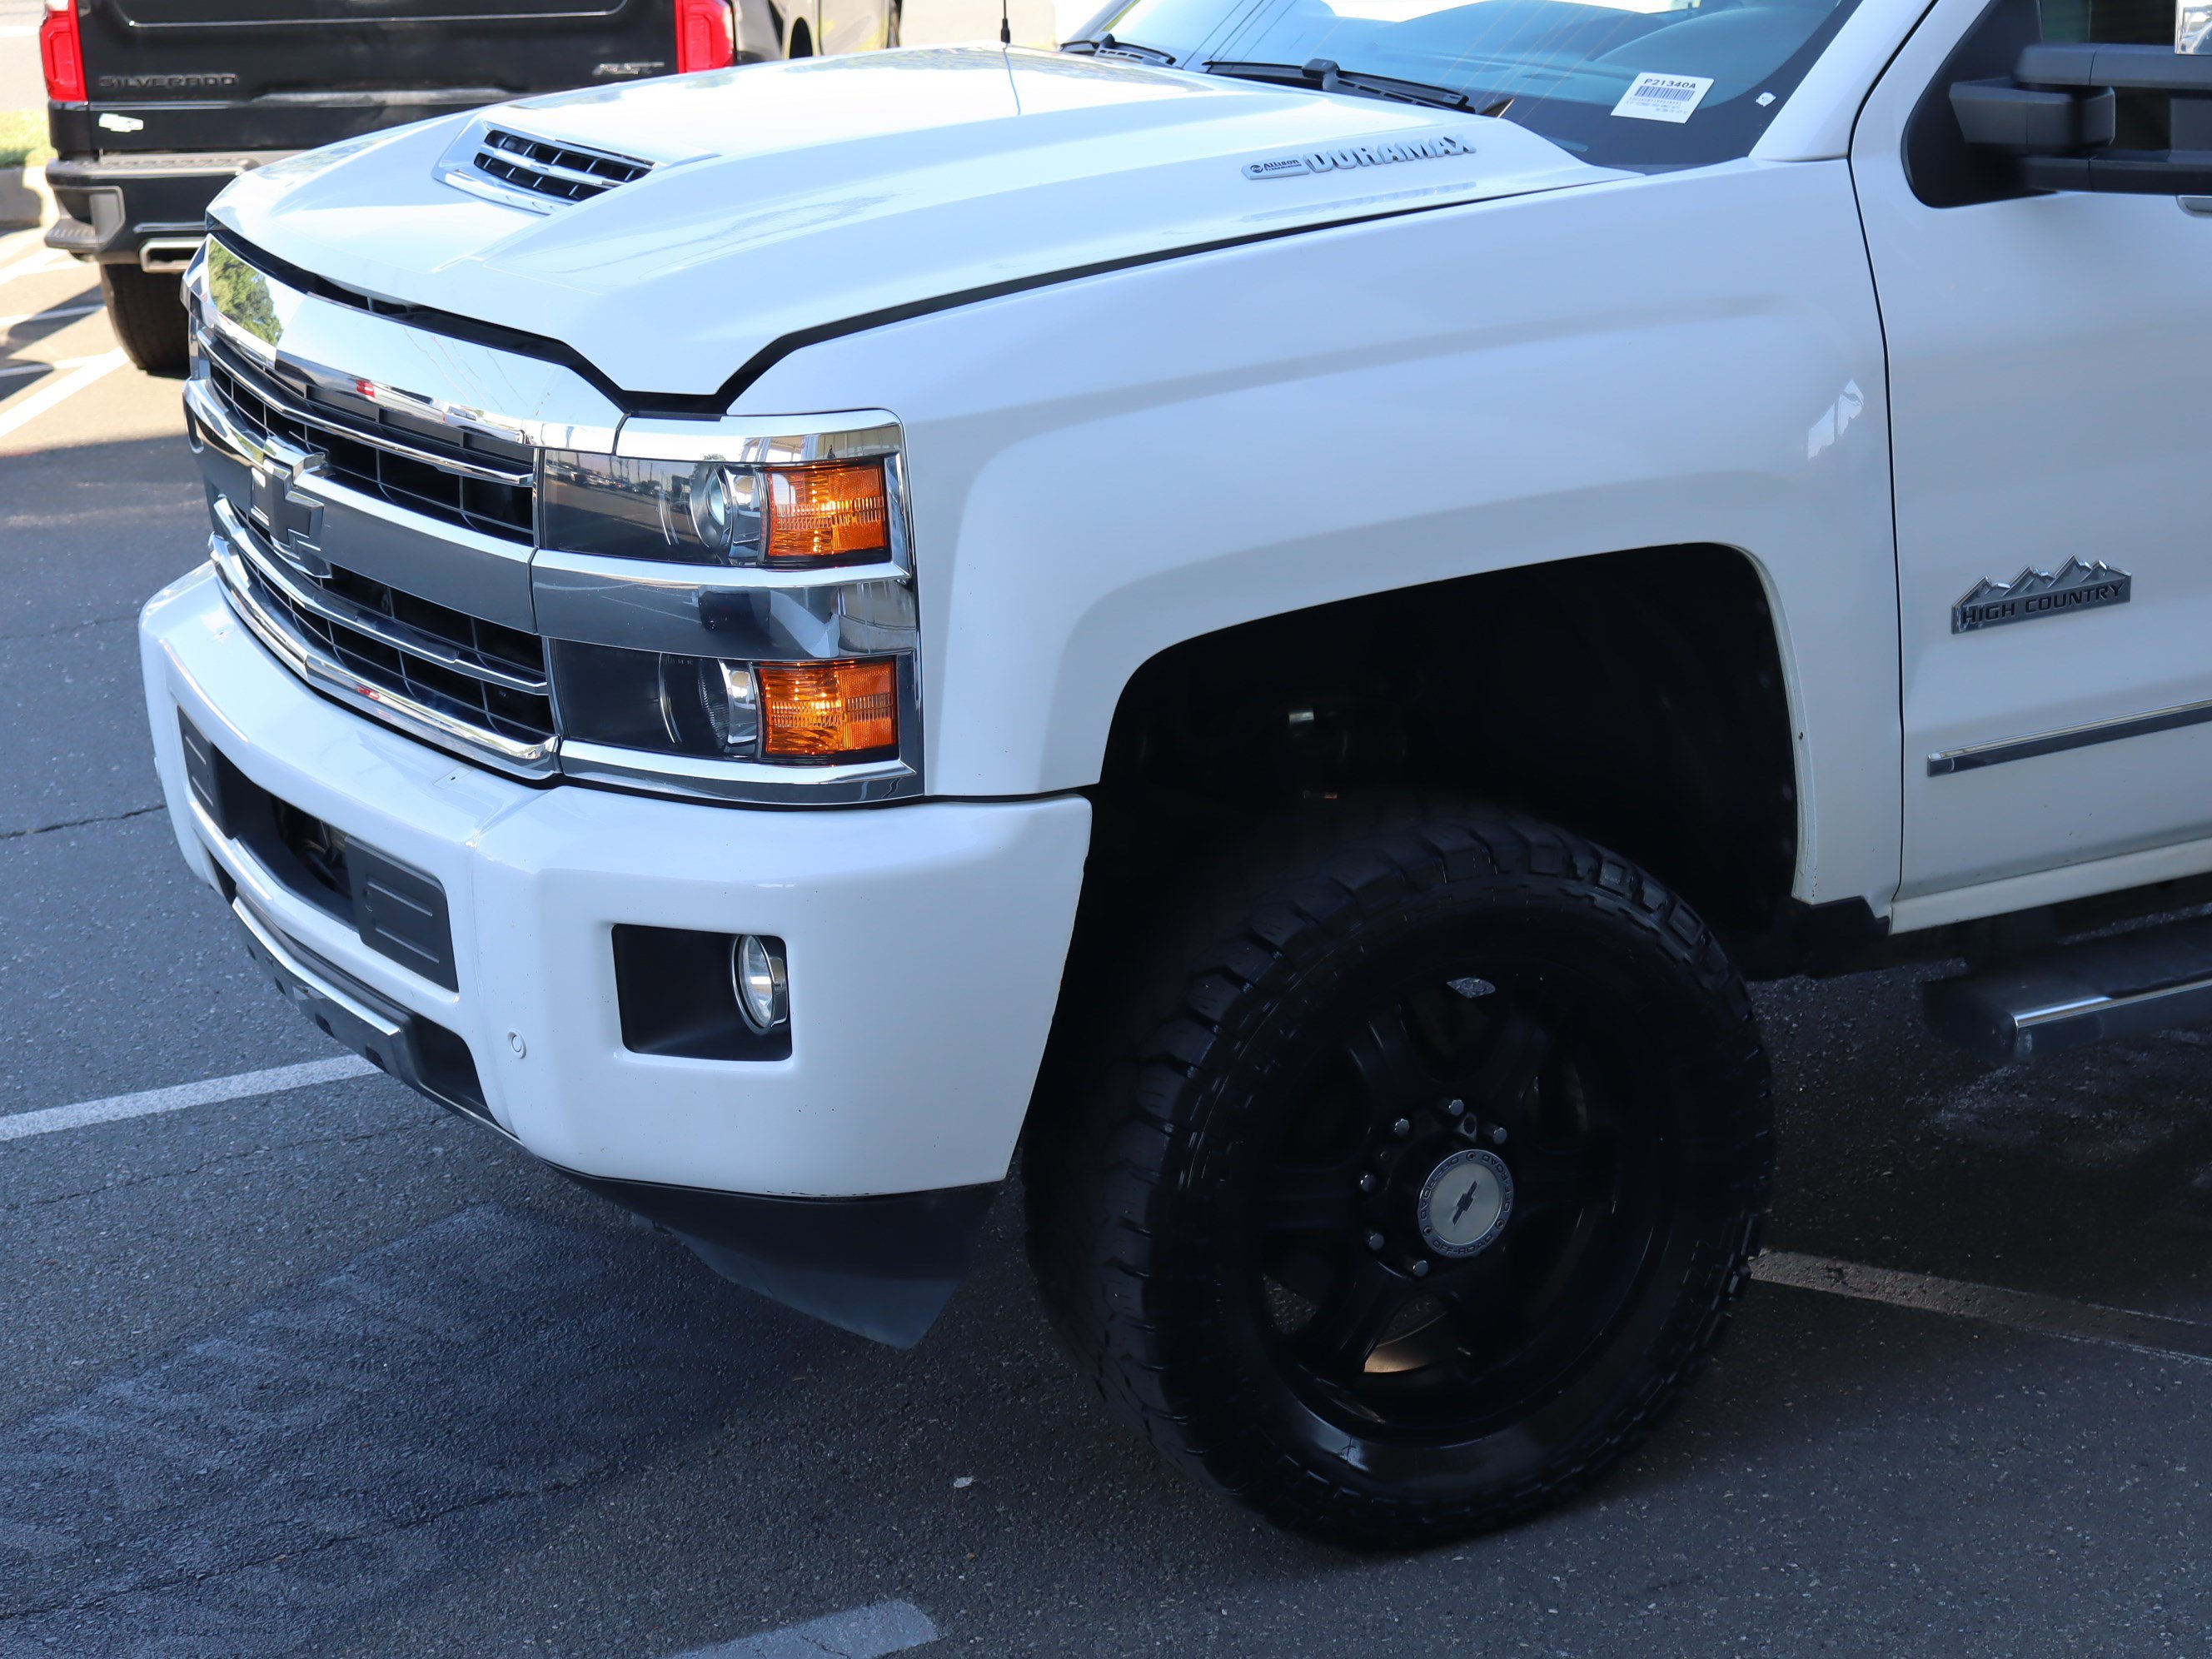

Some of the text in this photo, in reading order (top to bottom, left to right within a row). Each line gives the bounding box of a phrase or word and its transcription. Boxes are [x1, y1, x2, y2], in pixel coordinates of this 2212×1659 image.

[99, 73, 237, 87] SILVERADO
[1644, 78, 1696, 89] P21340A
[1263, 159, 1300, 168] Allison
[1303, 134, 1477, 173] DURAMAX
[1961, 582, 2124, 625] HIGH COUNTRY
[1420, 1157, 1459, 1221] OFF-ROAD
[1482, 1154, 1512, 1213] OFF-ROAD
[1432, 1234, 1493, 1254] OFF-ROAD
